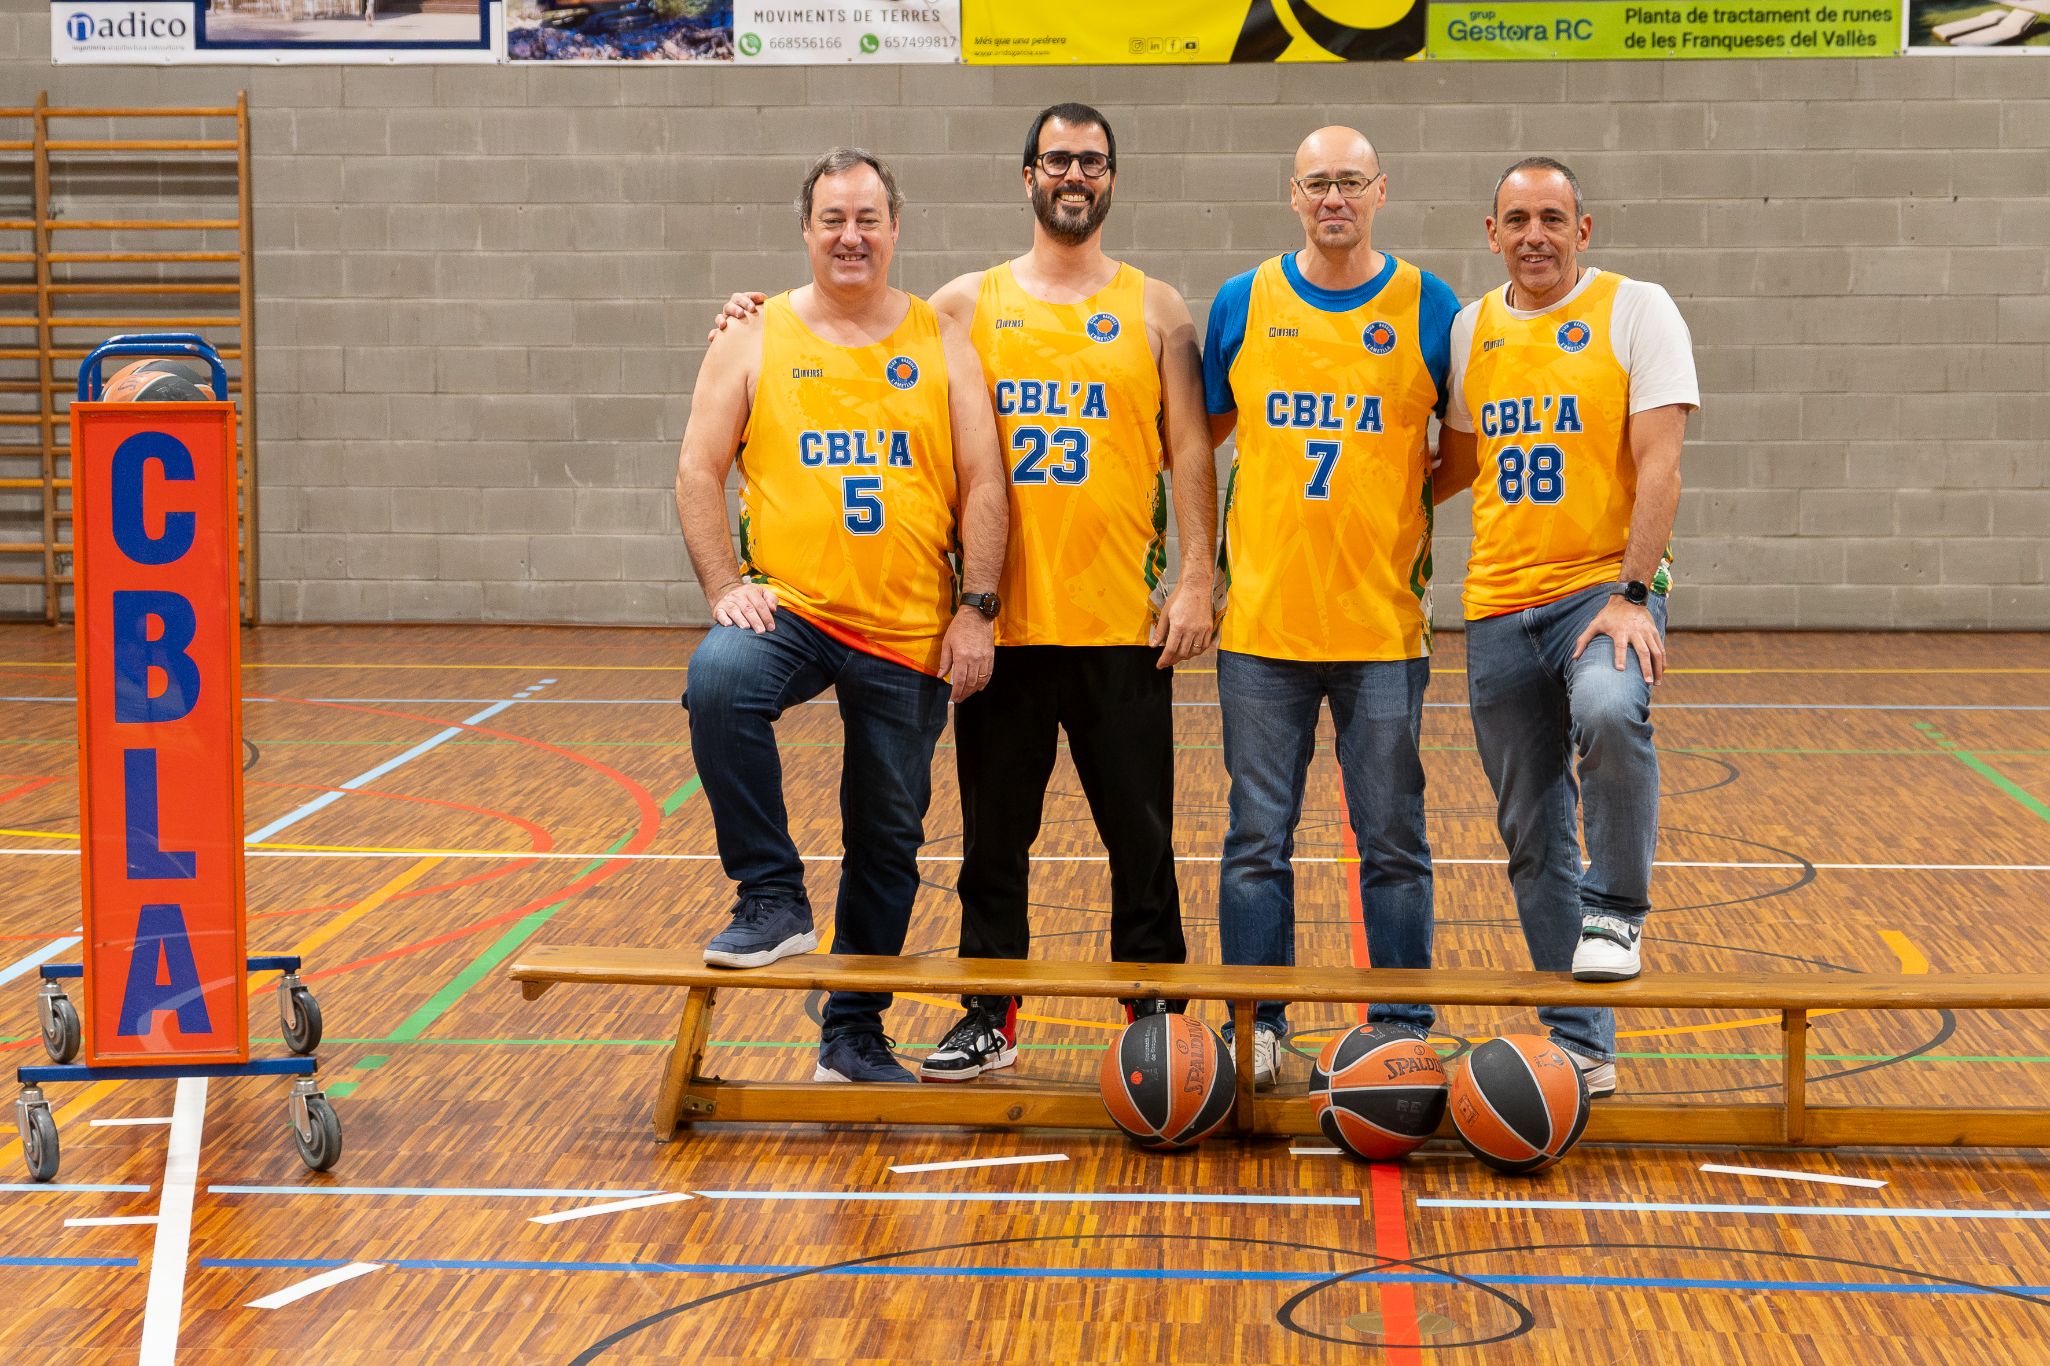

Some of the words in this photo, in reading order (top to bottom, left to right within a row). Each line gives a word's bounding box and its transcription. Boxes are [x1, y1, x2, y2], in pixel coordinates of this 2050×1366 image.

[67, 12, 187, 41] nadico
[754, 9, 846, 23] MOVIMENTS
[853, 9, 872, 22] DE
[881, 9, 941, 22] TERRES
[1447, 19, 1549, 42] Gestora
[1554, 18, 1594, 41] RC
[1469, 10, 1496, 21] grup
[1624, 7, 1682, 24] Planta
[1686, 7, 1708, 23] de
[1713, 7, 1811, 23] tractament
[1815, 7, 1837, 23] de
[1842, 8, 1893, 23] runes
[769, 36, 843, 49] 668556166
[884, 35, 958, 49] 657499817
[993, 37, 1010, 47] que
[1012, 37, 1030, 45] una
[1031, 34, 1067, 46] pedrera
[1624, 32, 1647, 48] de
[1651, 31, 1677, 48] les
[1682, 31, 1786, 51] Franqueses
[1790, 31, 1818, 47] del
[1822, 30, 1877, 47] Vallès
[995, 378, 1110, 420] CBL'A
[1265, 390, 1384, 435] CBL'A
[1480, 394, 1584, 439] CBL'A
[798, 429, 914, 468] CBL'A
[1010, 424, 1091, 487] 23
[1303, 438, 1343, 501] 7
[1495, 442, 1566, 506] 88
[841, 474, 886, 537] 5
[111, 430, 214, 1038] CBLA
[1182, 1017, 1206, 1096] SPALDING
[1384, 1057, 1447, 1080] SPALDIN
